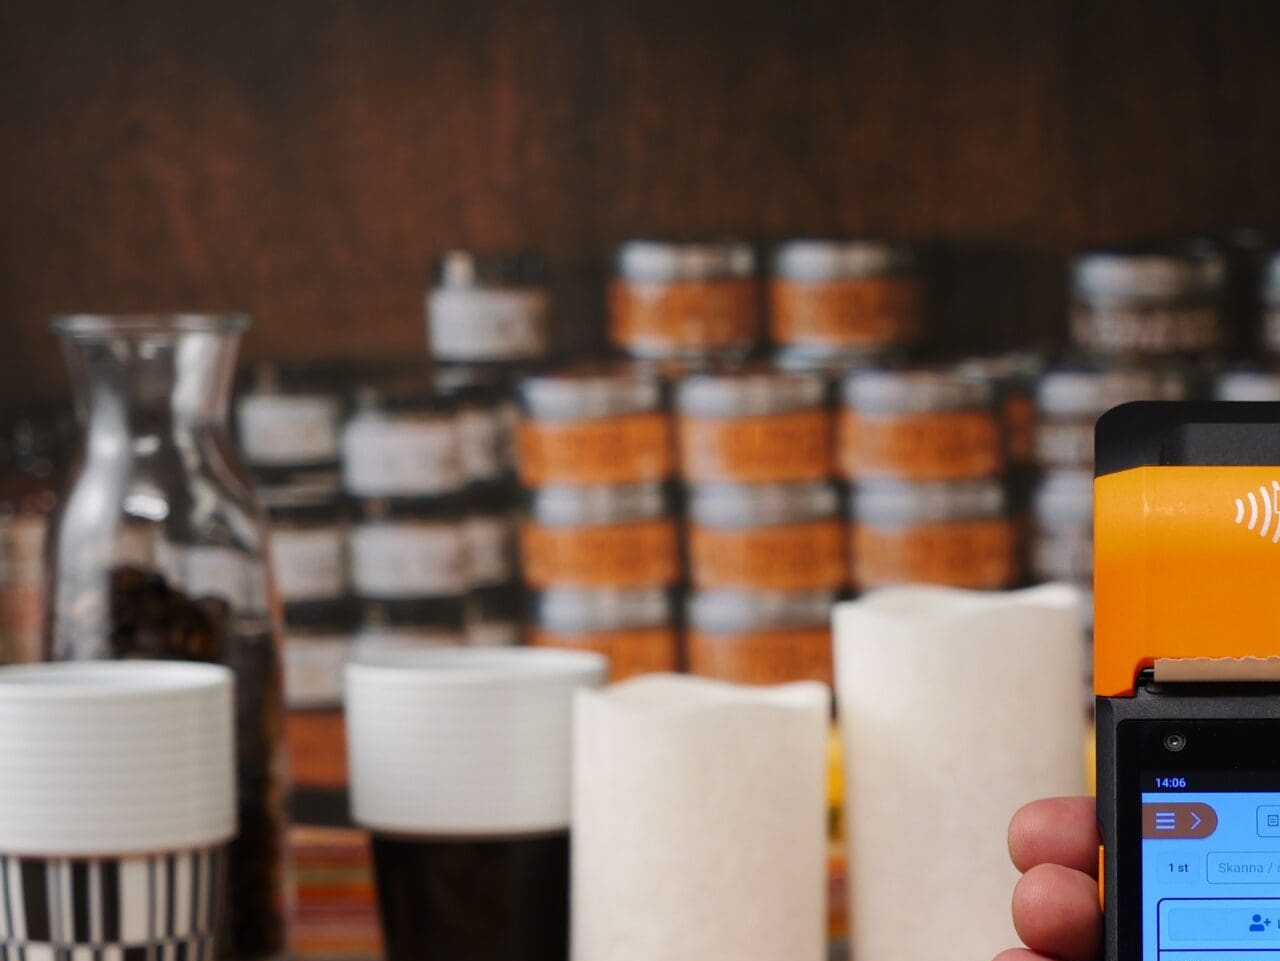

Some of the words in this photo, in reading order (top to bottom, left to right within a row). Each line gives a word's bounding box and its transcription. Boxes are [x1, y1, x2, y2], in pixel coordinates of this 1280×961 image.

[1155, 777, 1186, 788] 14:06
[1168, 863, 1174, 873] 1
[1177, 863, 1189, 873] st
[1218, 862, 1263, 873] Skanna
